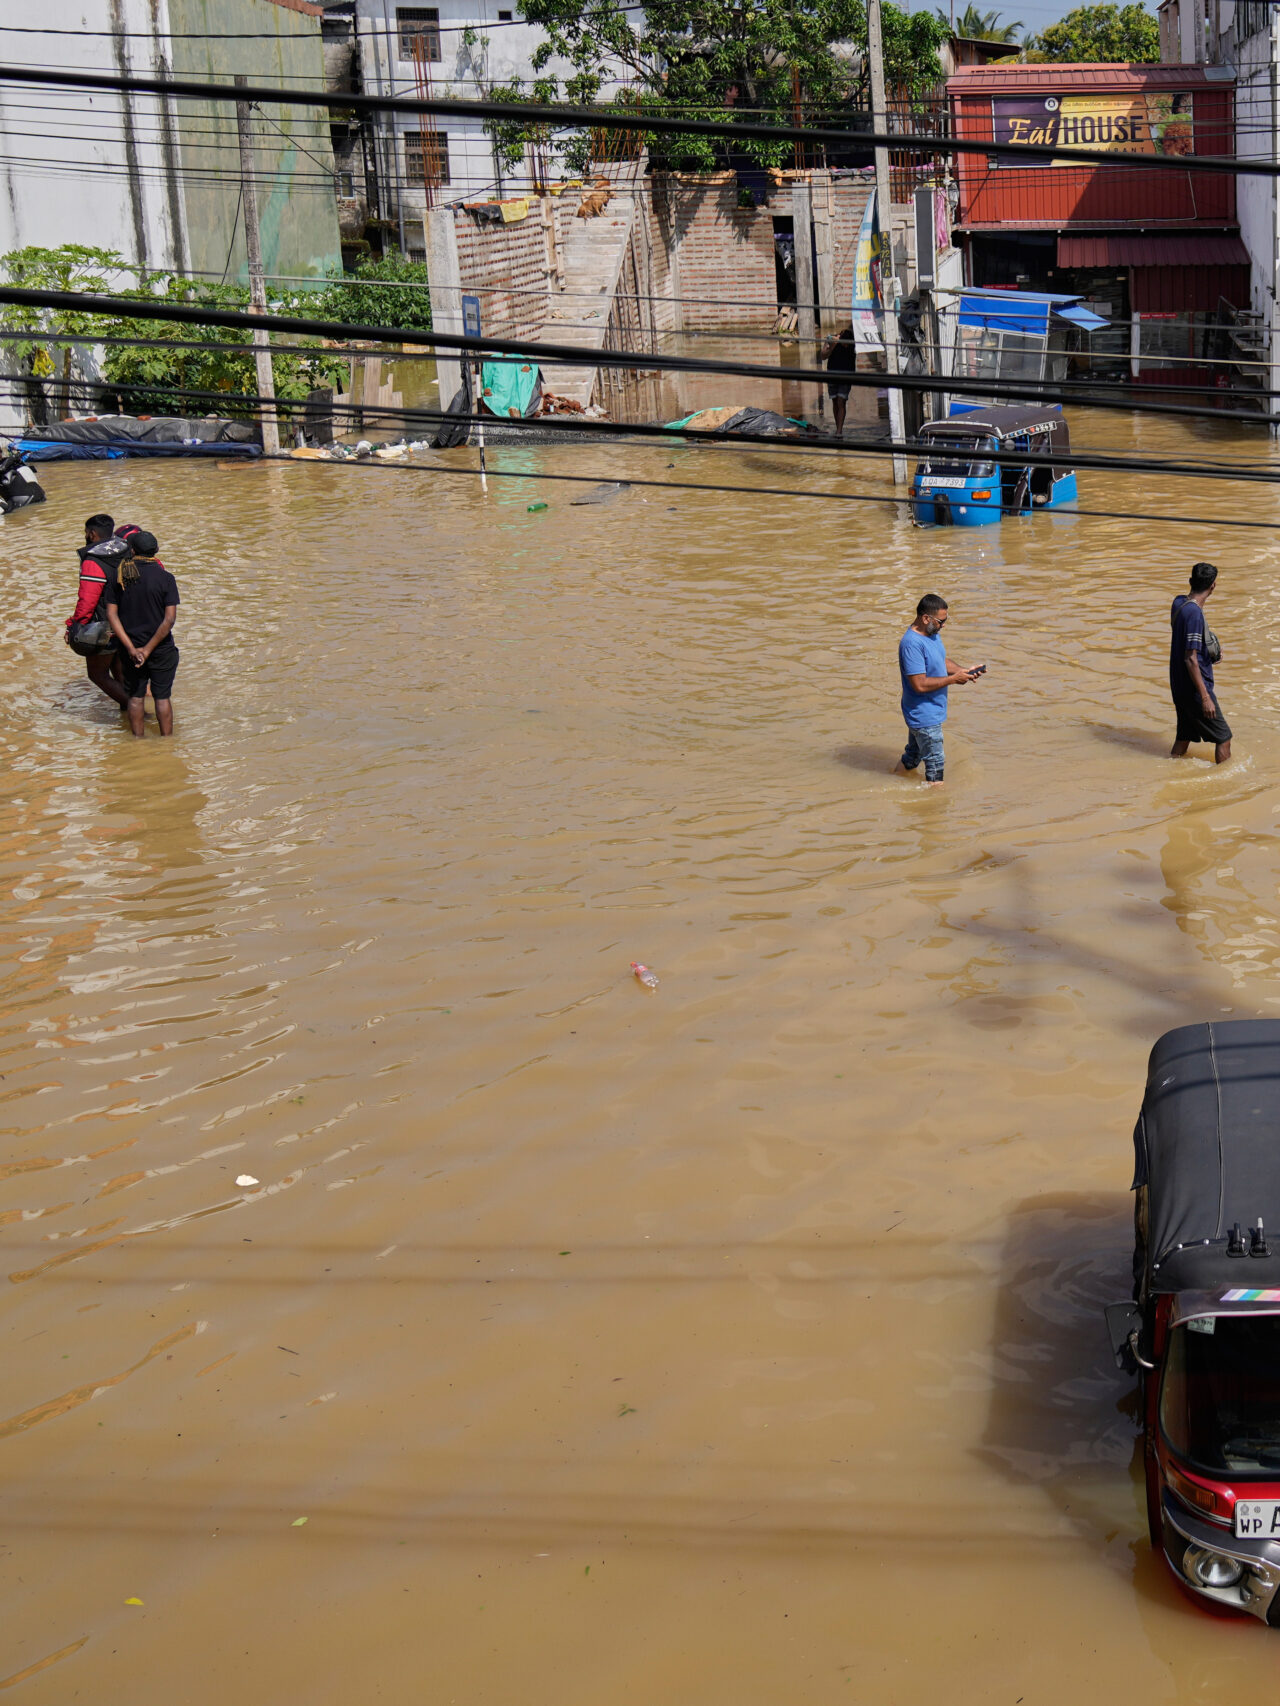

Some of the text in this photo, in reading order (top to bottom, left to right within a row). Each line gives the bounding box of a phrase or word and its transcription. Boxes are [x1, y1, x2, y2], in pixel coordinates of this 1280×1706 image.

[1008, 115, 1145, 145] Eat HOUSE
[1240, 1518, 1263, 1534] WP
